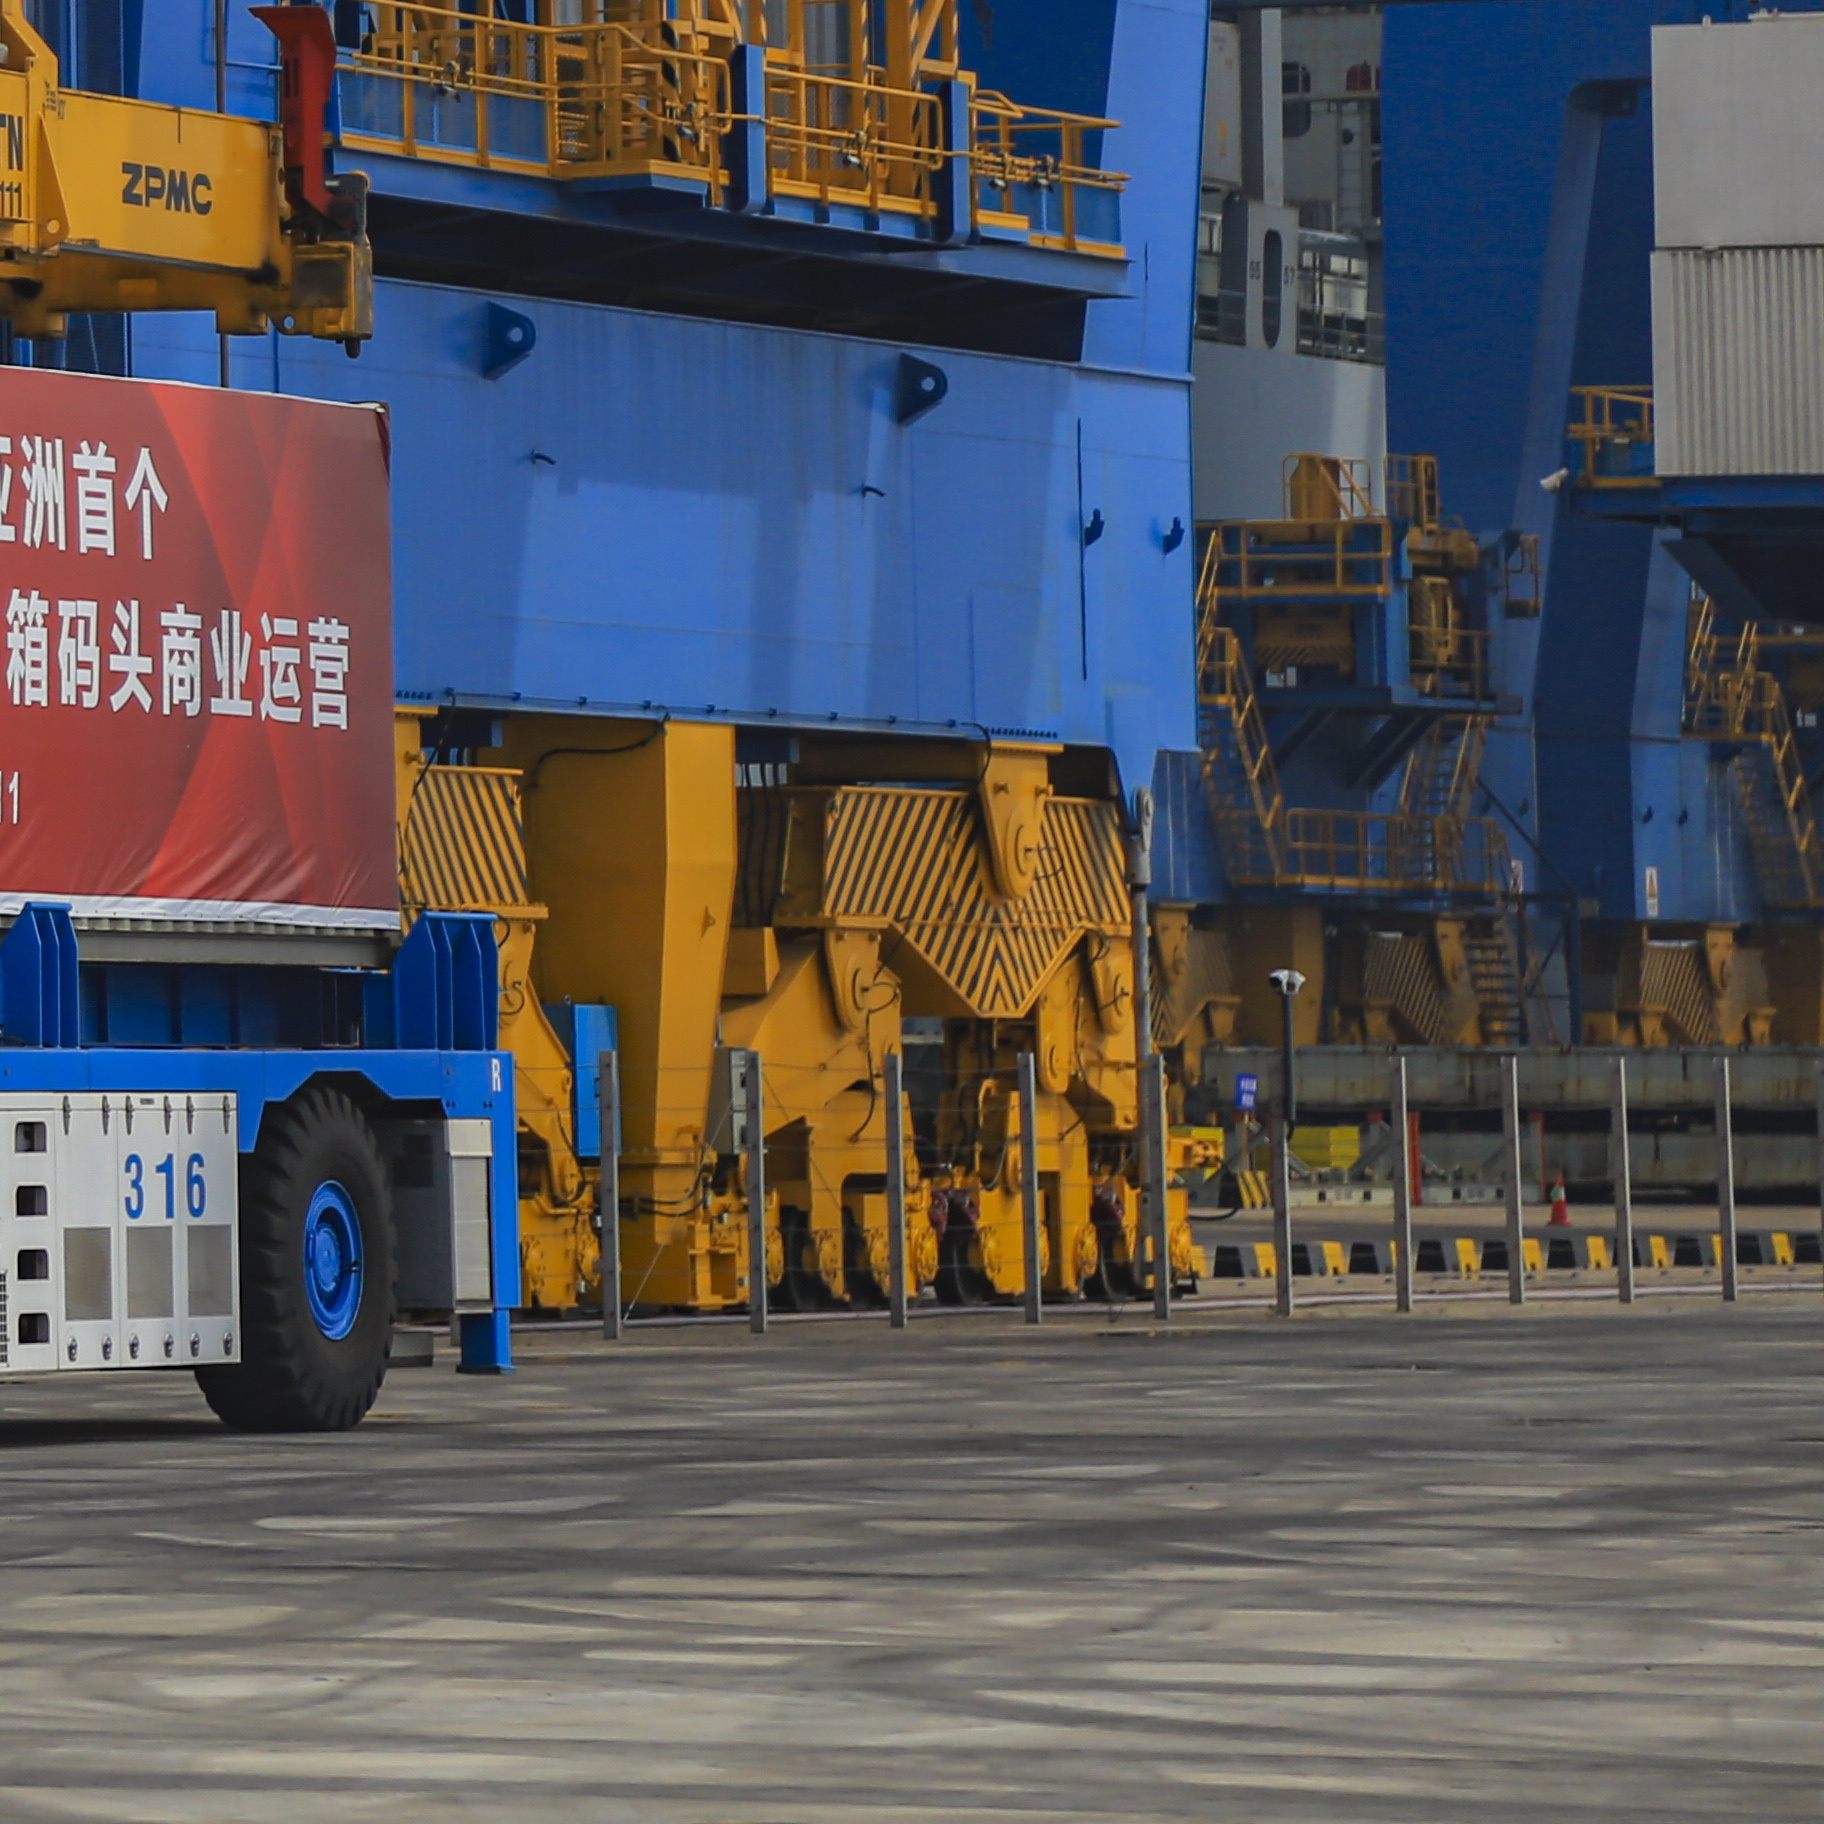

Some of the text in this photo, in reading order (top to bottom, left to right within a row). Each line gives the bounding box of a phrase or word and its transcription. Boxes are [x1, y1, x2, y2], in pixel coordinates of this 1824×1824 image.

[121, 161, 213, 216] ZPMC
[490, 1056, 502, 1093] R
[124, 1152, 207, 1220] 316
